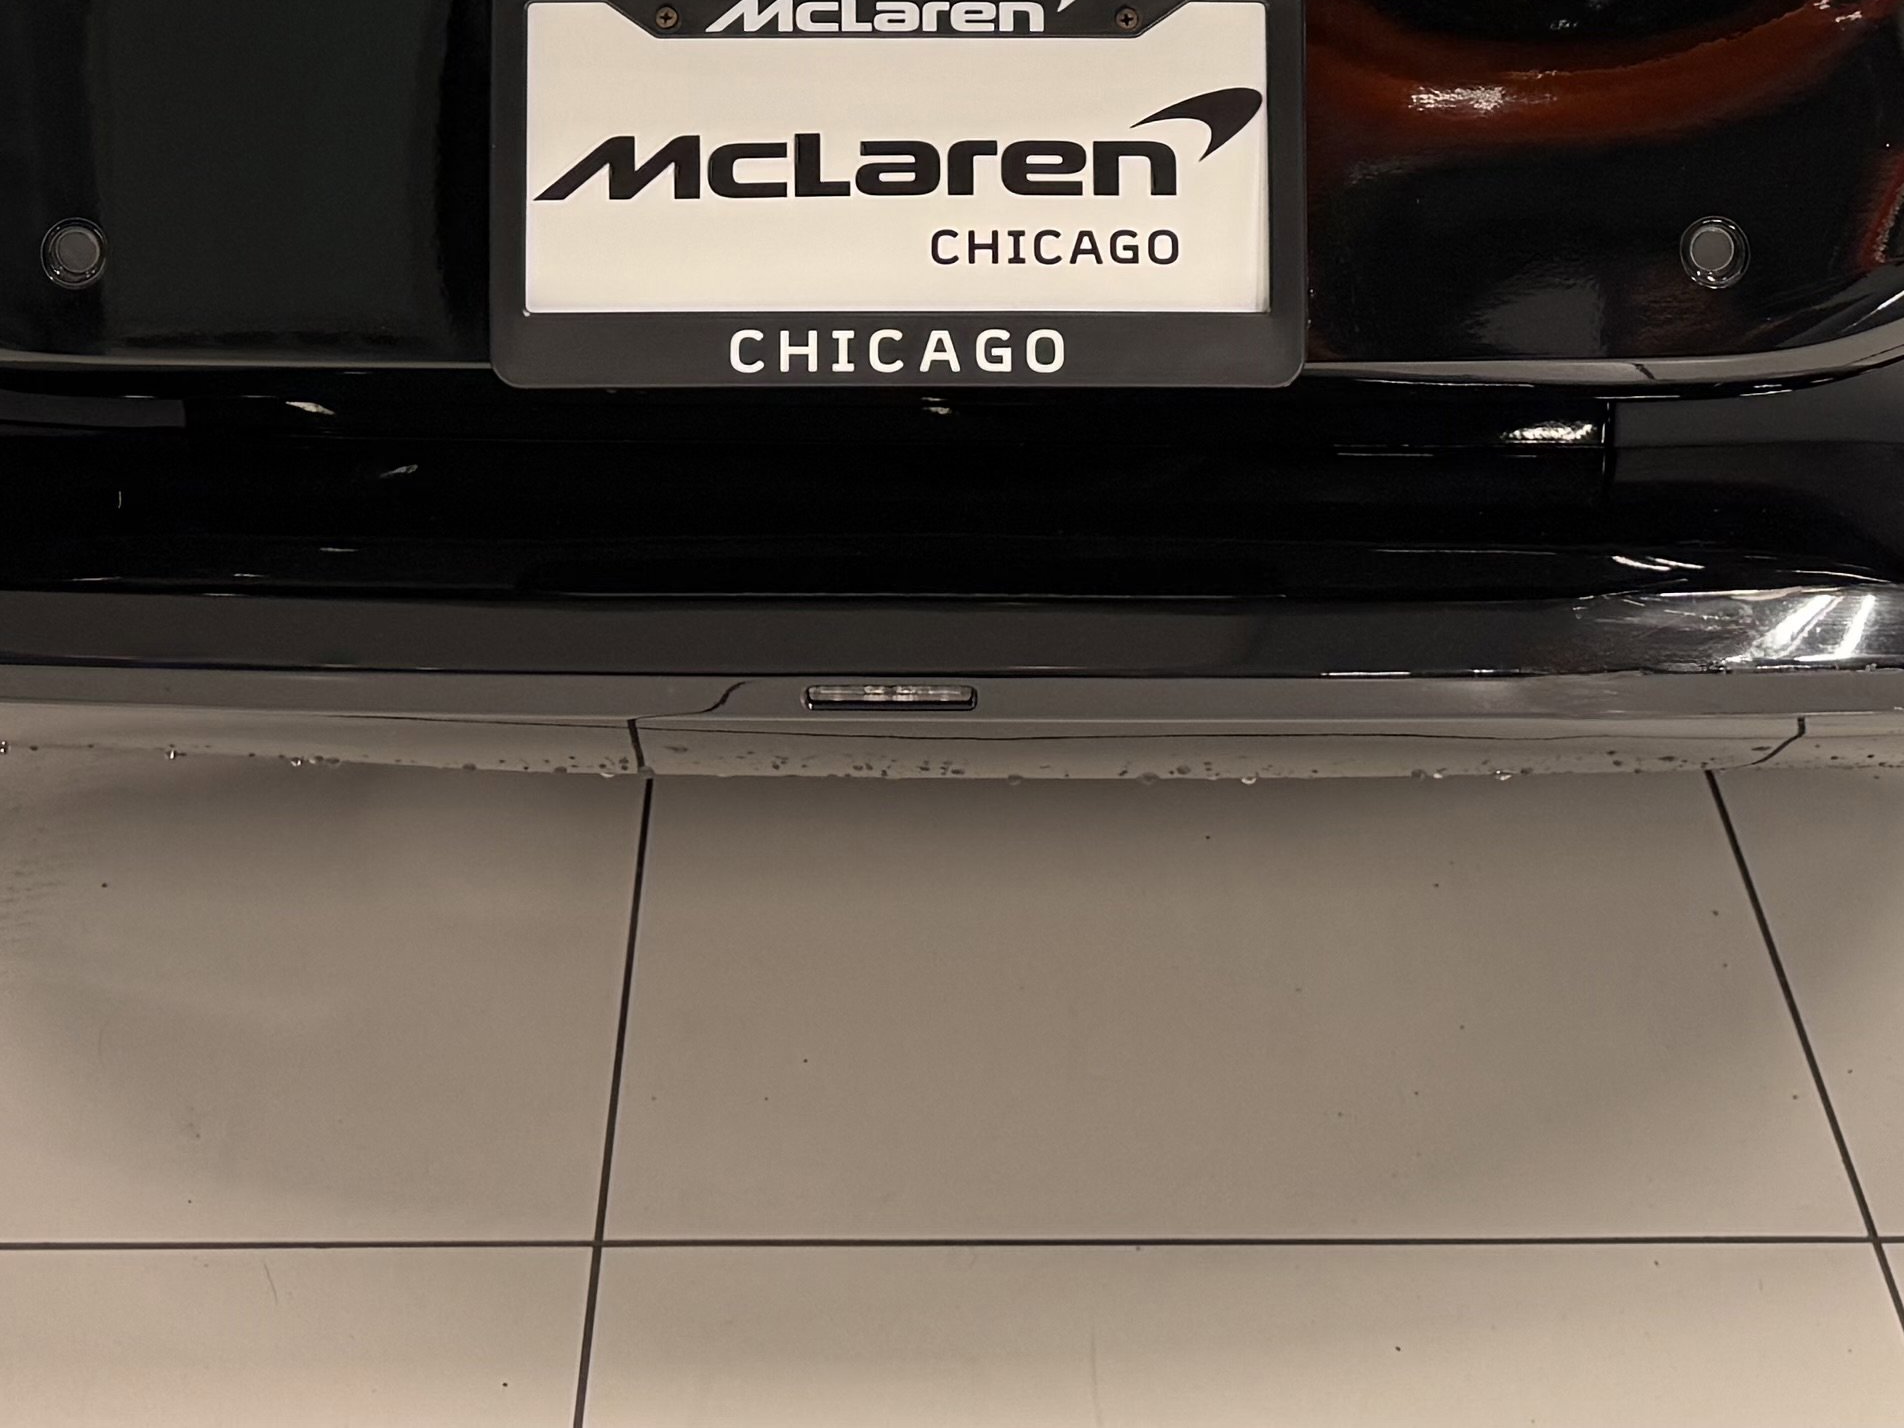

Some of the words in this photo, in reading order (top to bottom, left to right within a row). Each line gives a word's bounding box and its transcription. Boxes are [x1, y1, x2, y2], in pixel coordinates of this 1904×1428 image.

[533, 132, 1179, 202] McLaren
[930, 228, 1180, 266] CHICAGO
[728, 328, 1067, 375] CHICAGO
